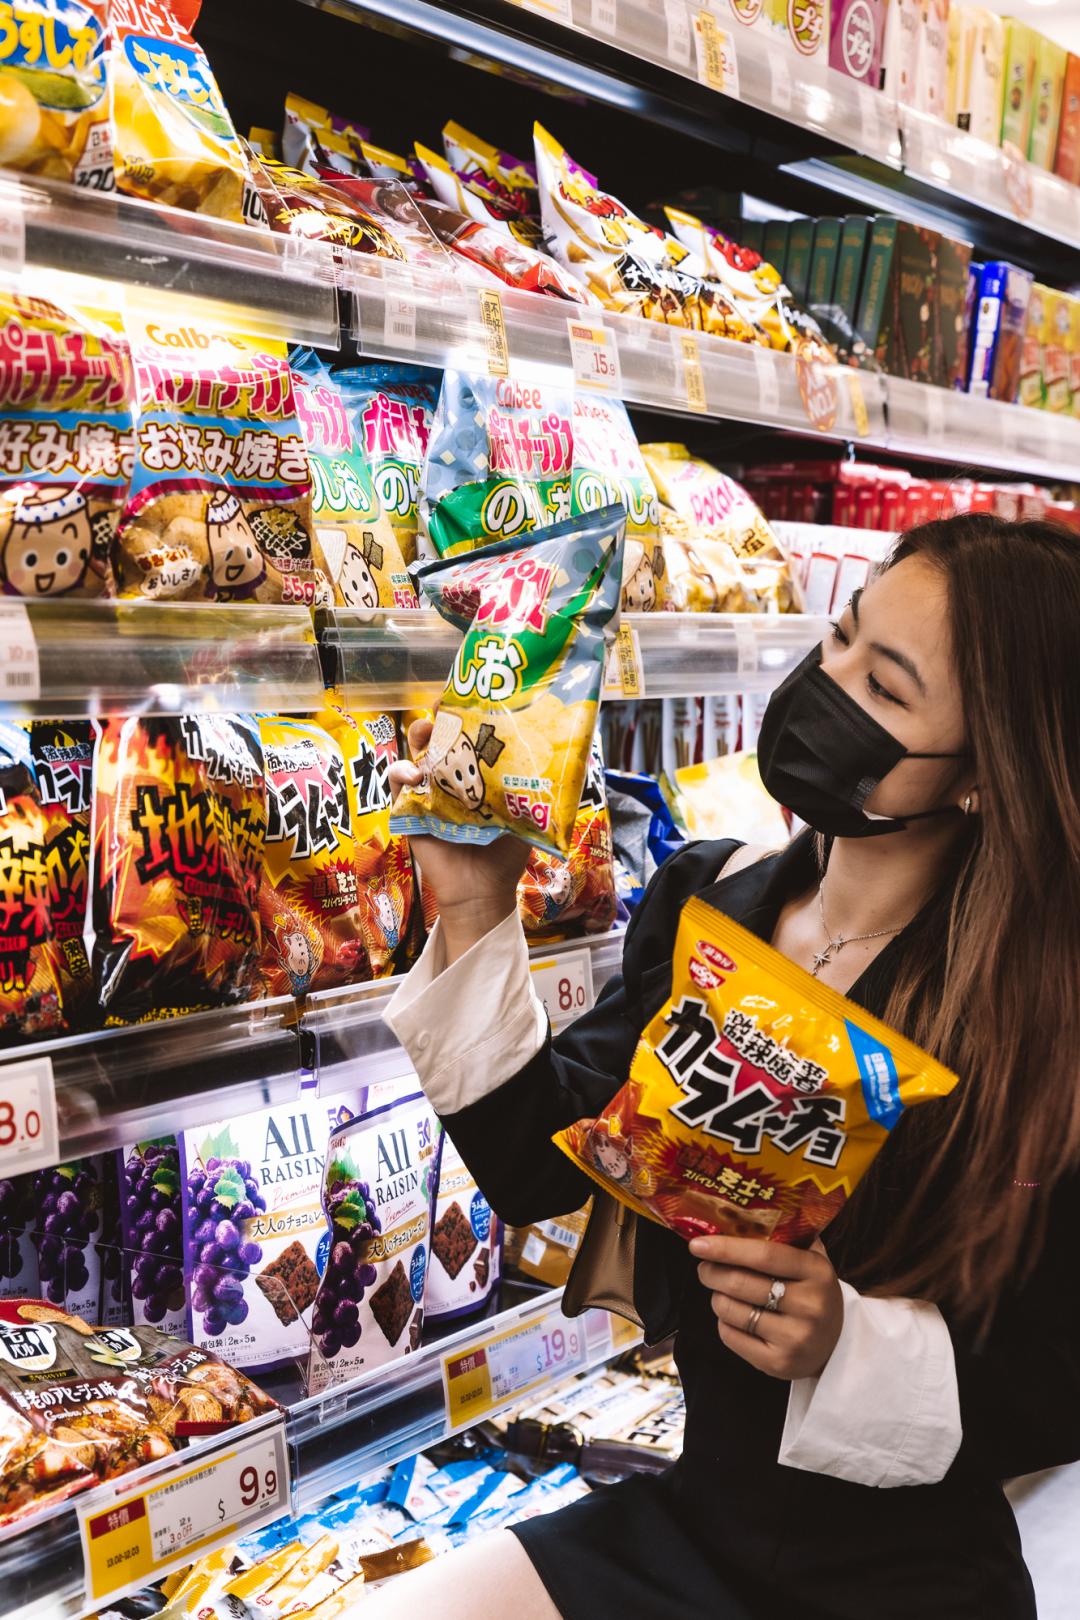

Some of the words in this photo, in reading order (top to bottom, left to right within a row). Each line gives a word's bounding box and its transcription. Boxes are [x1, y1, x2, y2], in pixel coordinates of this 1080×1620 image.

[139, 423, 310, 483] お好み焼き
[281, 575, 317, 608] 55g
[505, 792, 552, 834] 55g
[557, 977, 586, 1011] 8.0
[654, 995, 848, 1168] カラムーチョ
[261, 1113, 317, 1163] All
[375, 1128, 414, 1183] All
[260, 1154, 326, 1186] RAISIN
[375, 1169, 419, 1207] RAISIN
[540, 1327, 580, 1369] 19.9
[217, 1498, 226, 1522] $
[239, 1465, 279, 1506] 9.9
[107, 1507, 131, 1532] 特價
